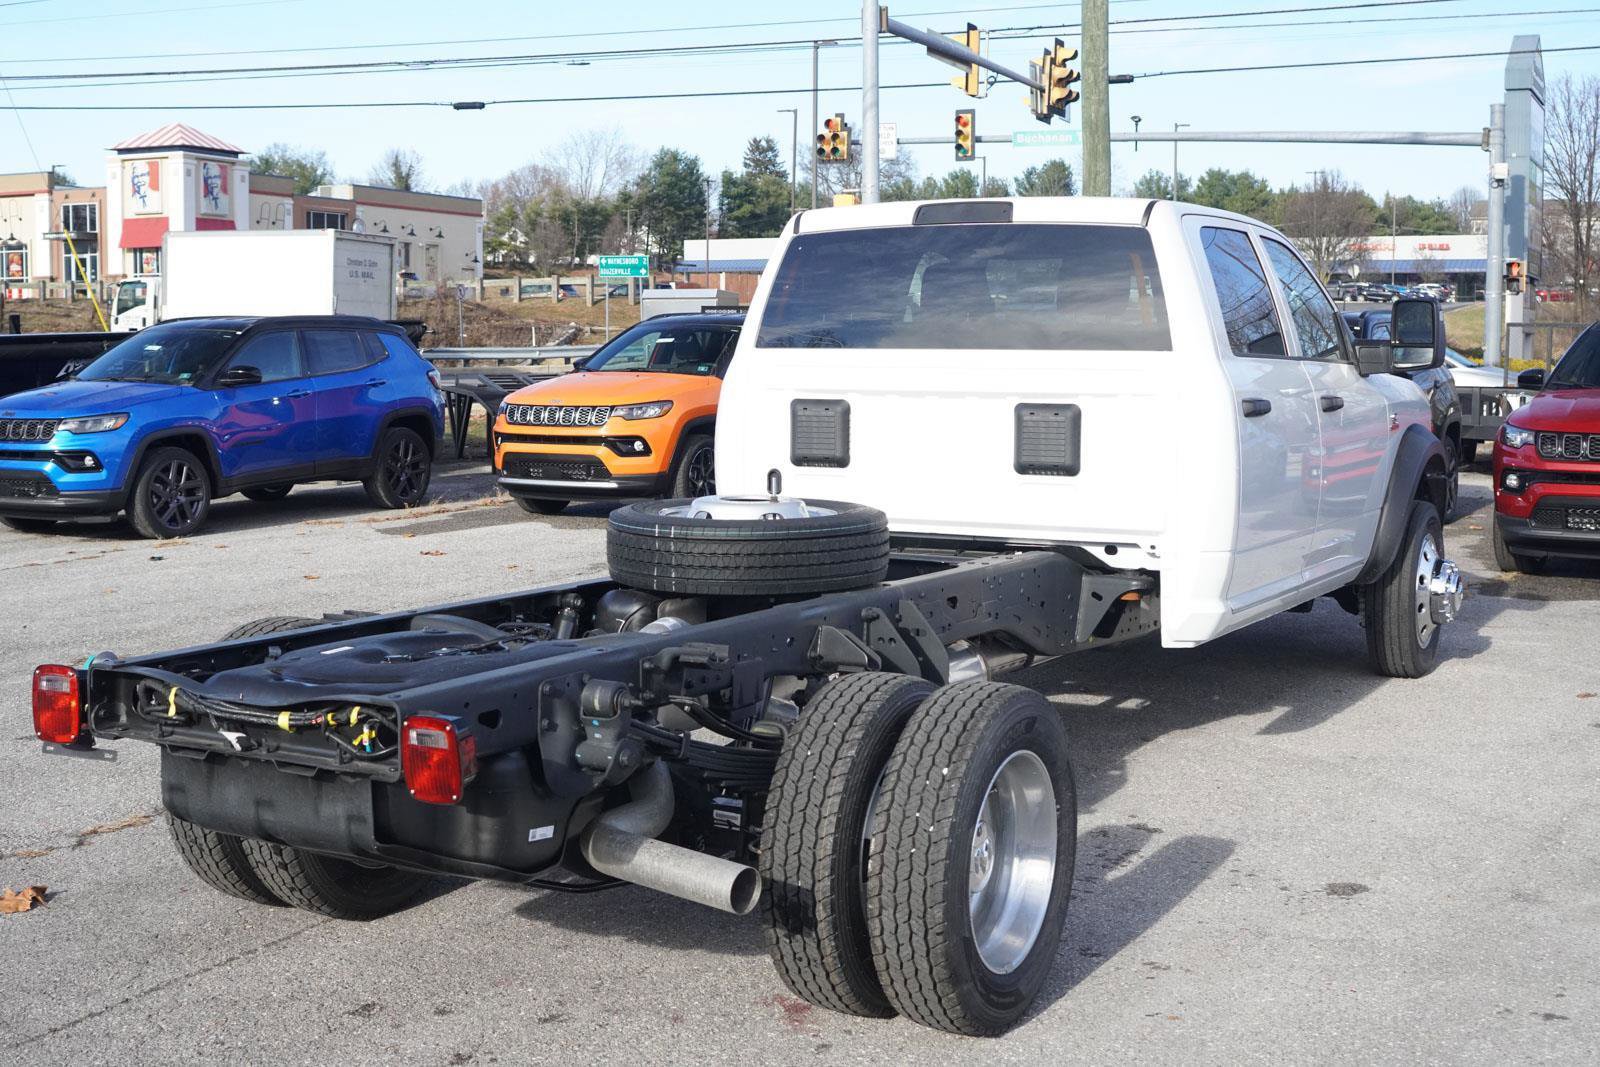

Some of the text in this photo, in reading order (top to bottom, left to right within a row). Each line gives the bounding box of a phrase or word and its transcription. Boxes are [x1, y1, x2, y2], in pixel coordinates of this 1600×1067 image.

[1016, 133, 1072, 144] Buchanan
[607, 257, 639, 265] WAYNESBORO
[361, 271, 376, 280] MAIL
